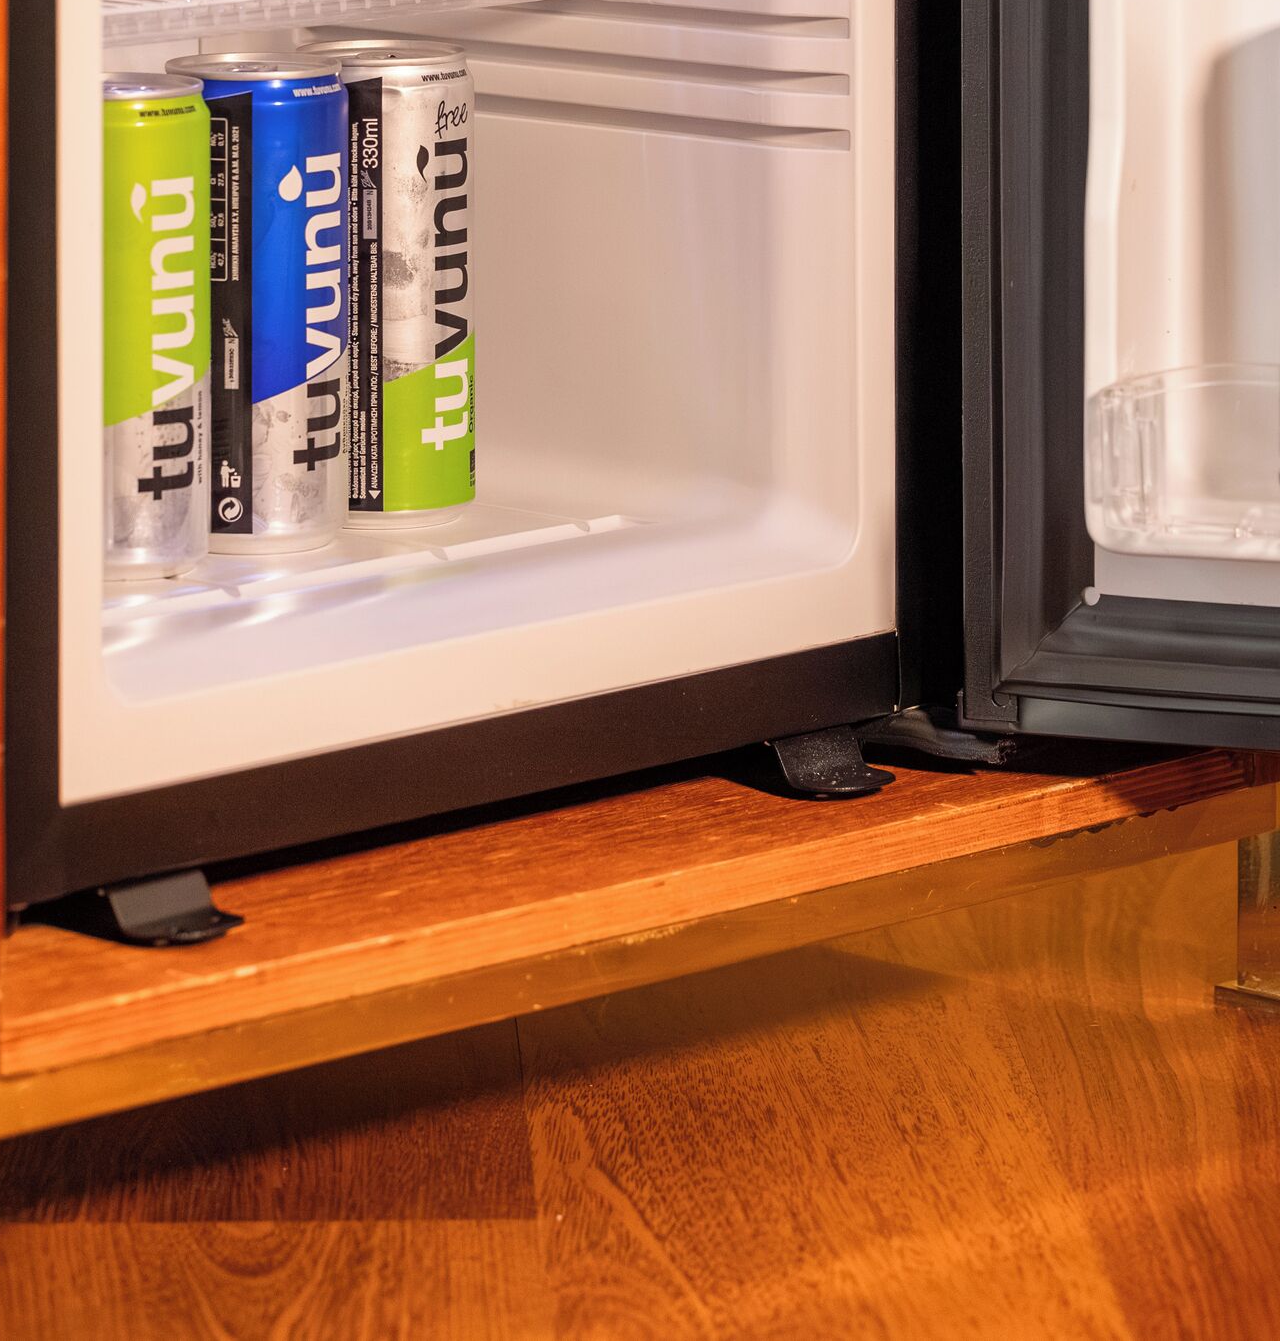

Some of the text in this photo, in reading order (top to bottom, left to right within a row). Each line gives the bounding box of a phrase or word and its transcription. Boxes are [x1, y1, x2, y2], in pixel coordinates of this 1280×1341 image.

[231, 126, 240, 143] 2021
[434, 101, 468, 140] free
[361, 118, 379, 169] 330ml
[370, 241, 378, 254] BIS:
[370, 255, 378, 283] HALTBAR
[352, 293, 360, 302] dry
[370, 284, 378, 323] MINDESTENS
[421, 136, 469, 451] tuvunu
[293, 152, 342, 472] tuvunu
[138, 176, 197, 501] tuvunu
[370, 328, 378, 354] BEFORE:
[370, 355, 378, 371] BEST
[370, 376, 378, 392] ΑΠΟ:
